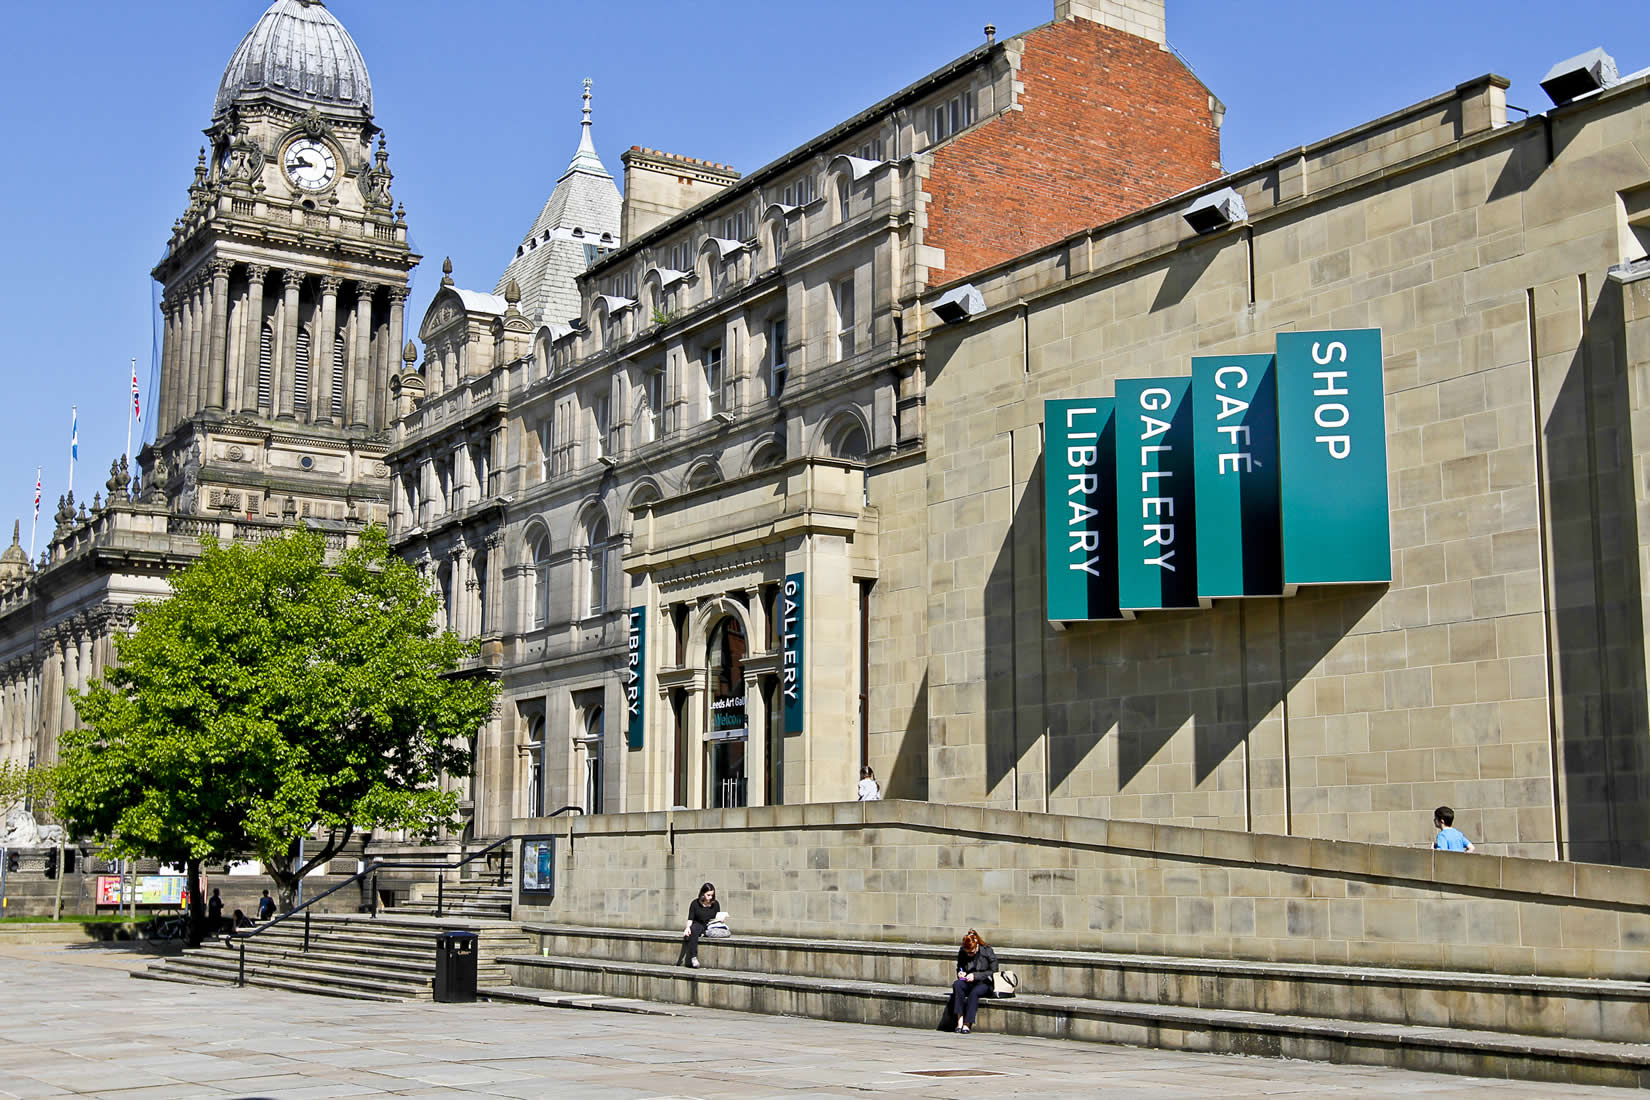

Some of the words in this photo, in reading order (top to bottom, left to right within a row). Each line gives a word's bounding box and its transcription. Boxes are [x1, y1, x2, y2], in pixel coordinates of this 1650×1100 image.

[1214, 366, 1263, 475] CAFÉ
[1311, 341, 1350, 459] SHOP
[1066, 407, 1100, 577] LIBRARY
[1140, 387, 1176, 572] GALLERY
[628, 612, 639, 715] LIBRARY
[784, 580, 797, 699] GALLERY
[726, 698, 734, 707] Art
